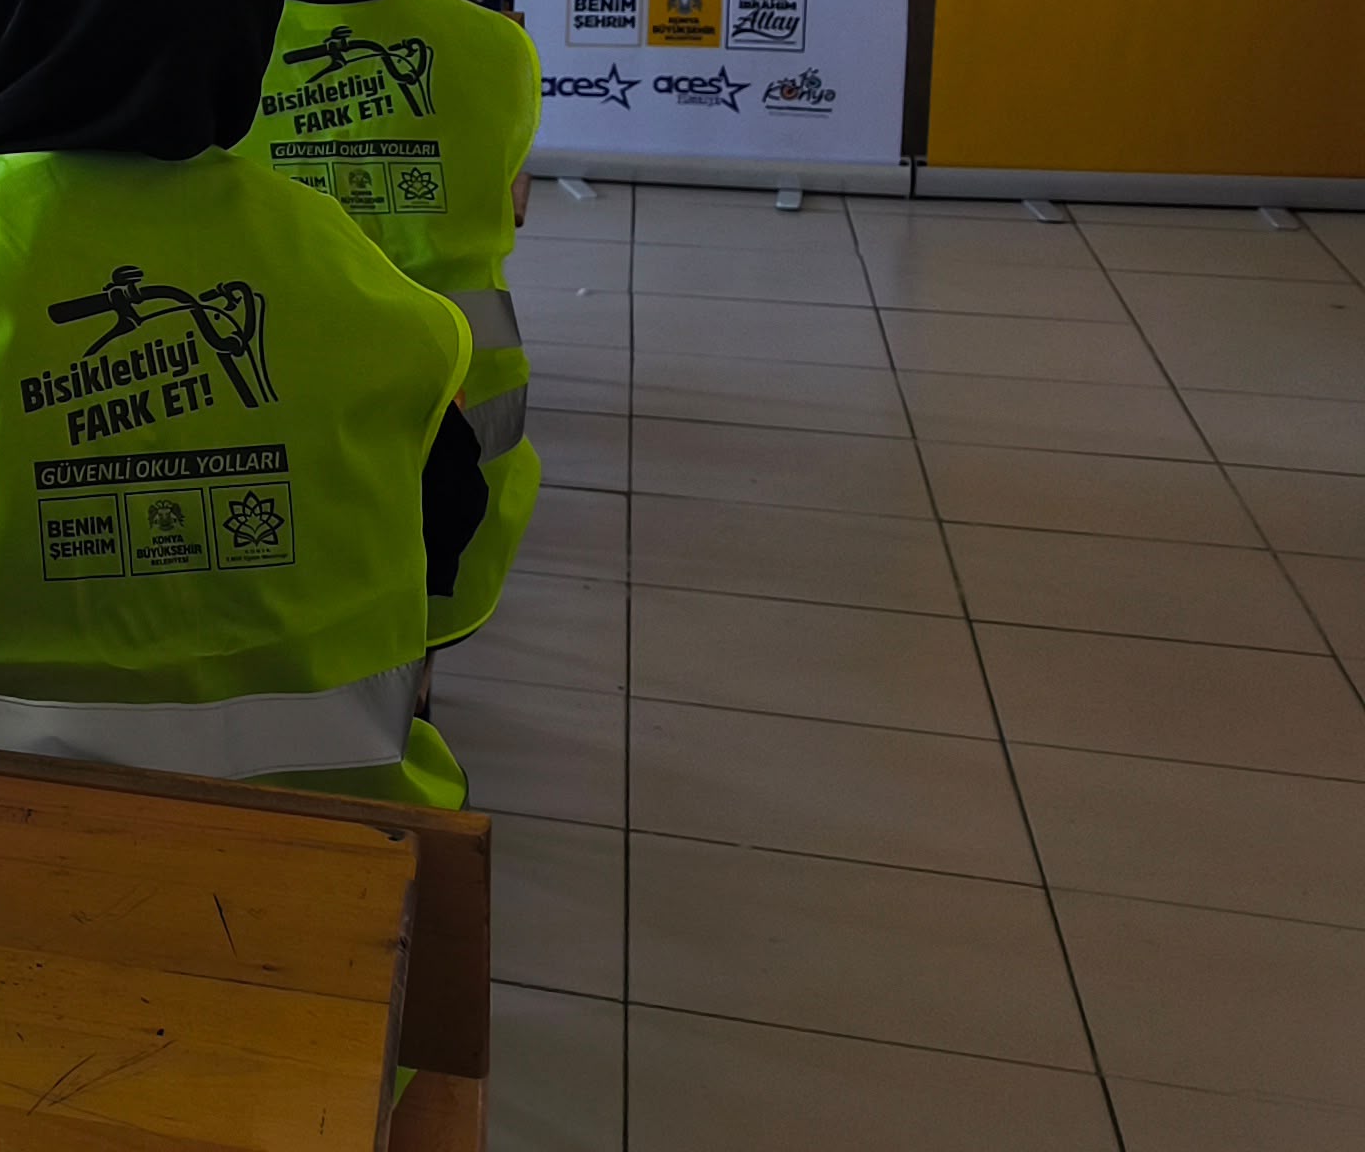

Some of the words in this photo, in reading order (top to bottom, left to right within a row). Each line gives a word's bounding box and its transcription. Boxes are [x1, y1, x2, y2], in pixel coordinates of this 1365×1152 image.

[574, 15, 636, 29] ŞEHRİM
[261, 70, 386, 116] Bisikletliyi
[541, 77, 610, 97] aces
[653, 75, 723, 96] aces
[294, 105, 353, 135] FARK
[359, 95, 394, 121] ET!
[275, 142, 336, 157] GÜVENLİ
[339, 144, 376, 156] OKUL
[380, 143, 436, 156] YOLLARI
[20, 331, 199, 413] Bisikletliyi
[67, 390, 156, 446] FARK
[162, 373, 214, 418] ET!
[41, 458, 131, 485] GÜVENLİ
[136, 456, 190, 477] OKUL
[197, 451, 280, 473] YOLLARI
[47, 516, 114, 538] BENİM
[49, 538, 115, 560] ŞEHRİM
[152, 534, 184, 545] KONYA
